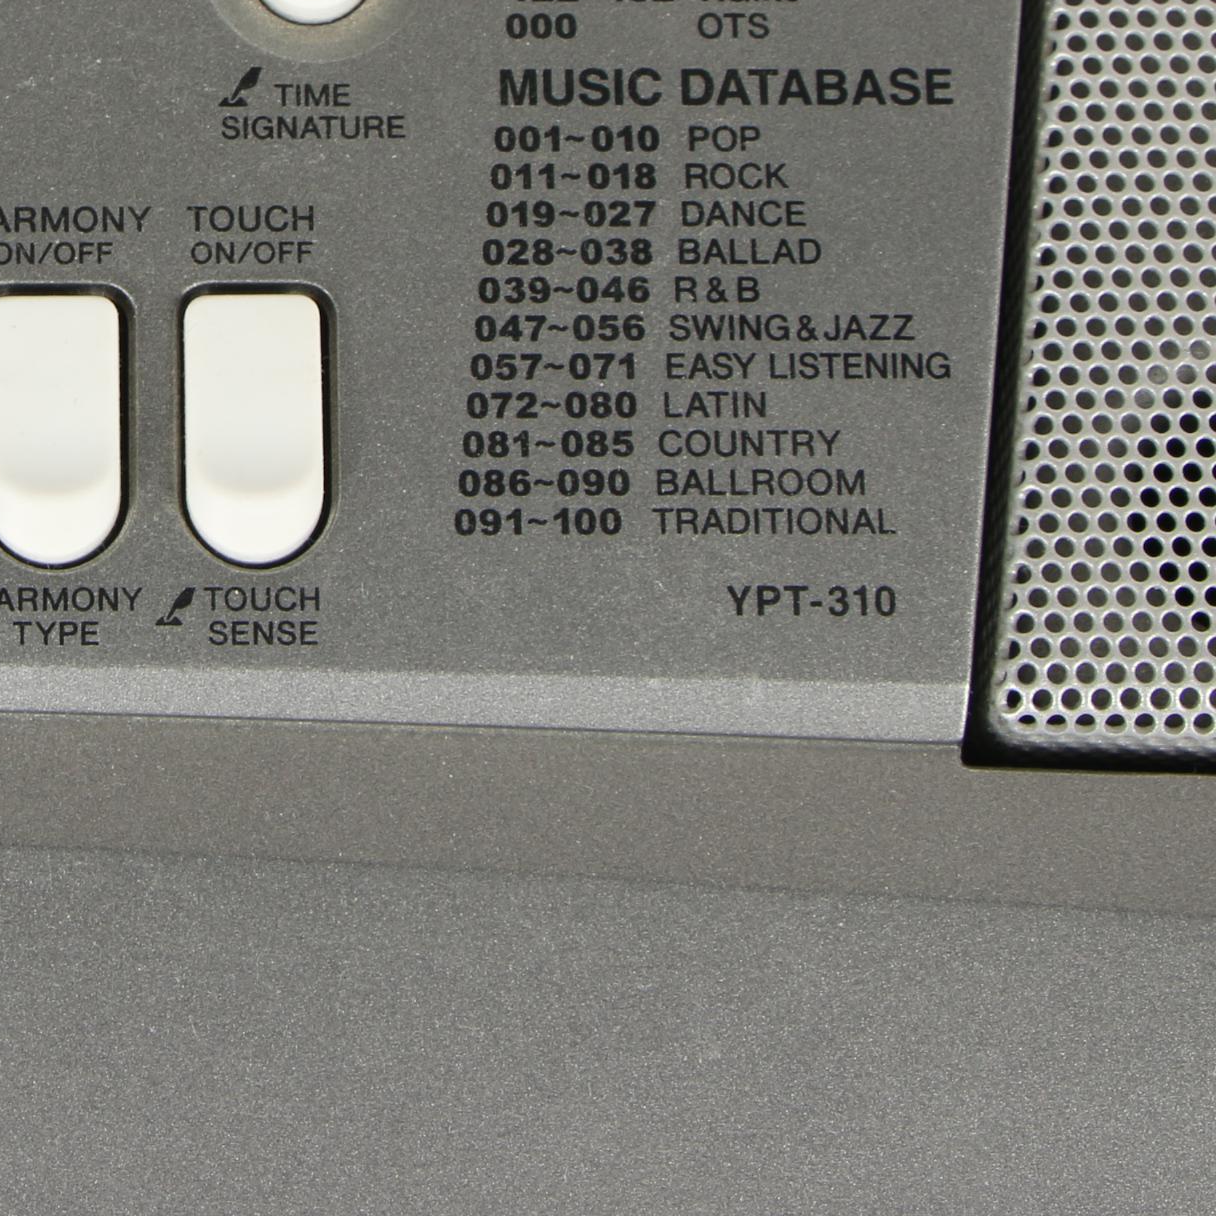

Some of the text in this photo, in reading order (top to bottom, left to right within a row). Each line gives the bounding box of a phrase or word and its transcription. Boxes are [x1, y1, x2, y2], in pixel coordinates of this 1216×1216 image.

[505, 12, 770, 40] 000 OTS
[273, 83, 351, 108] TIME
[499, 67, 954, 107] MUSIC DATABASE
[221, 114, 406, 141] SIGNATURE
[493, 124, 761, 153] 001~010 POP
[490, 162, 789, 191] 011~018 ROCK
[186, 204, 315, 233] TOUCH
[486, 199, 807, 228] 019~027 DANCE
[190, 240, 314, 265] ON/OFF
[482, 237, 822, 266] 028~038 BALLAD
[477, 276, 651, 305] 039~046
[474, 313, 646, 343] 047~056
[470, 351, 951, 381] 057~071 EASY LISTENING
[466, 390, 767, 420] 072~080 LATIN
[462, 429, 841, 459] 081~085 COUNTRY
[458, 468, 866, 498] 086~090 BALLROOM
[454, 506, 897, 537] 091~100 TRADITIONAL
[203, 585, 320, 613] TOUCH
[726, 584, 897, 617] YPT-310
[12, 620, 100, 646] TYPE
[208, 619, 319, 646] SENSE
